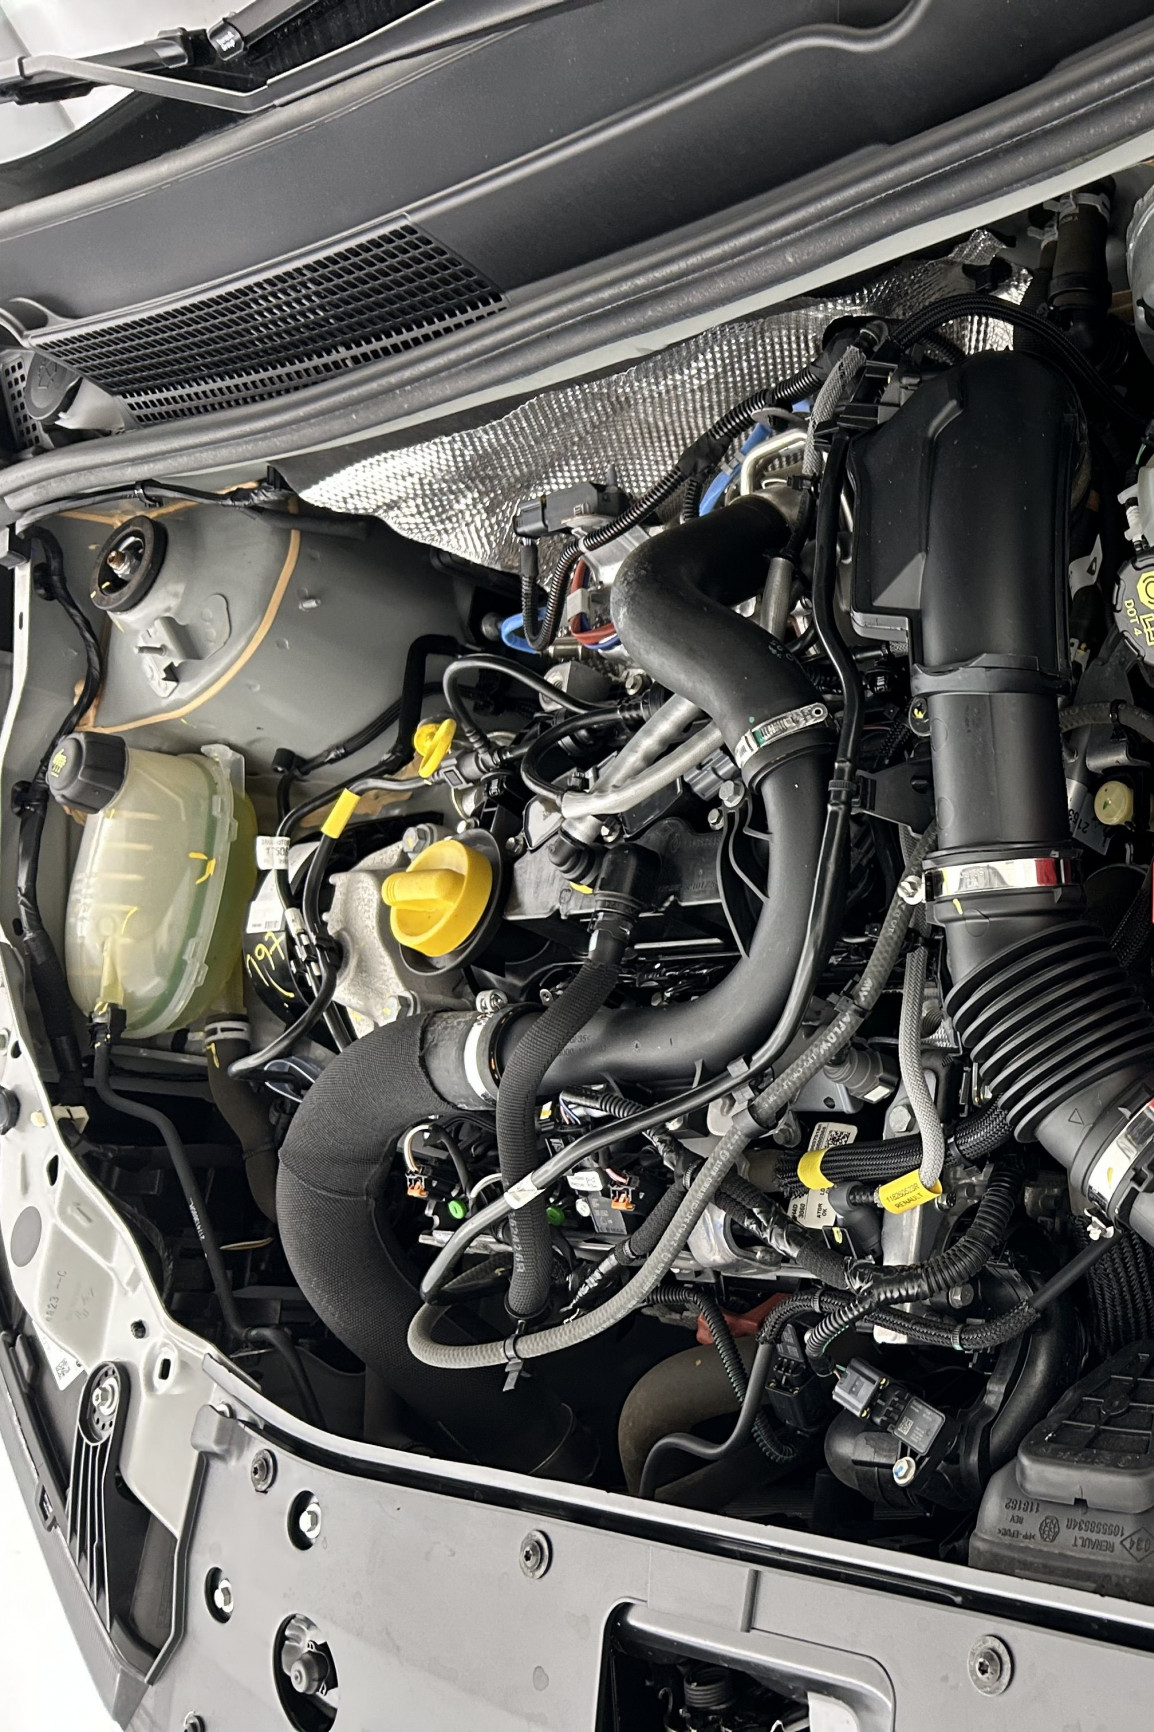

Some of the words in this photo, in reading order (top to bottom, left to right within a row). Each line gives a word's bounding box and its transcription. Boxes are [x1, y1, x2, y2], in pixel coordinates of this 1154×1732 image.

[1125, 599, 1140, 624] DOT
[1133, 627, 1143, 637] 4
[894, 1192, 925, 1209] RENAULT
[1010, 1514, 1024, 1525] REV
[1072, 1536, 1115, 1553] RENAULT
